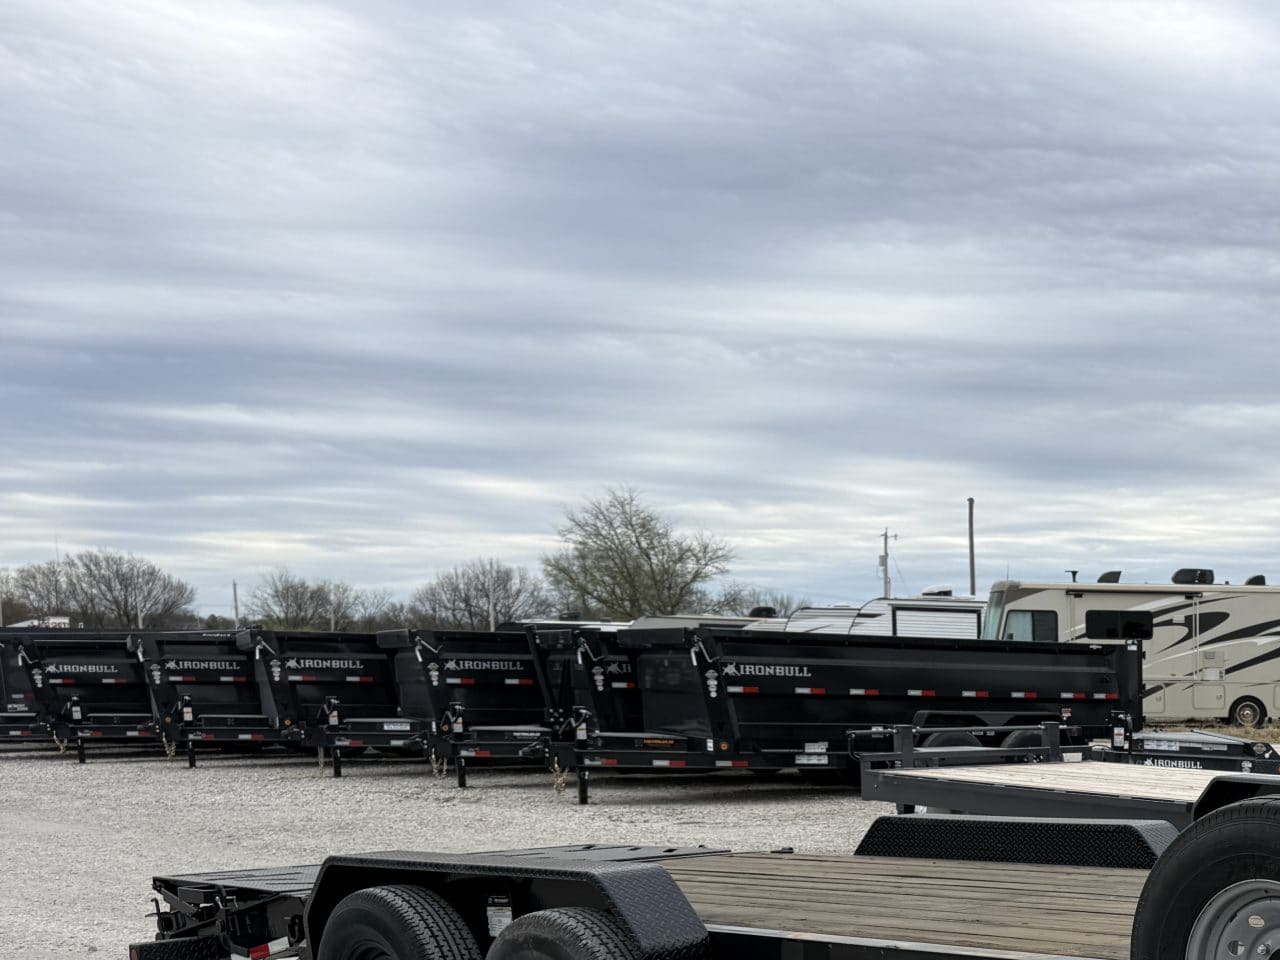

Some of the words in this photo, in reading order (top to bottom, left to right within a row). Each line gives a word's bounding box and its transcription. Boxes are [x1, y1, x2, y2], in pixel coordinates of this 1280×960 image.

[59, 665, 118, 673] IRONBULL
[179, 661, 240, 670] IRONBULL
[300, 660, 364, 669] IRONBULL
[459, 661, 524, 670] IRONBULL
[740, 664, 811, 677] IRONBULL
[1154, 759, 1203, 769] IRONBULL
